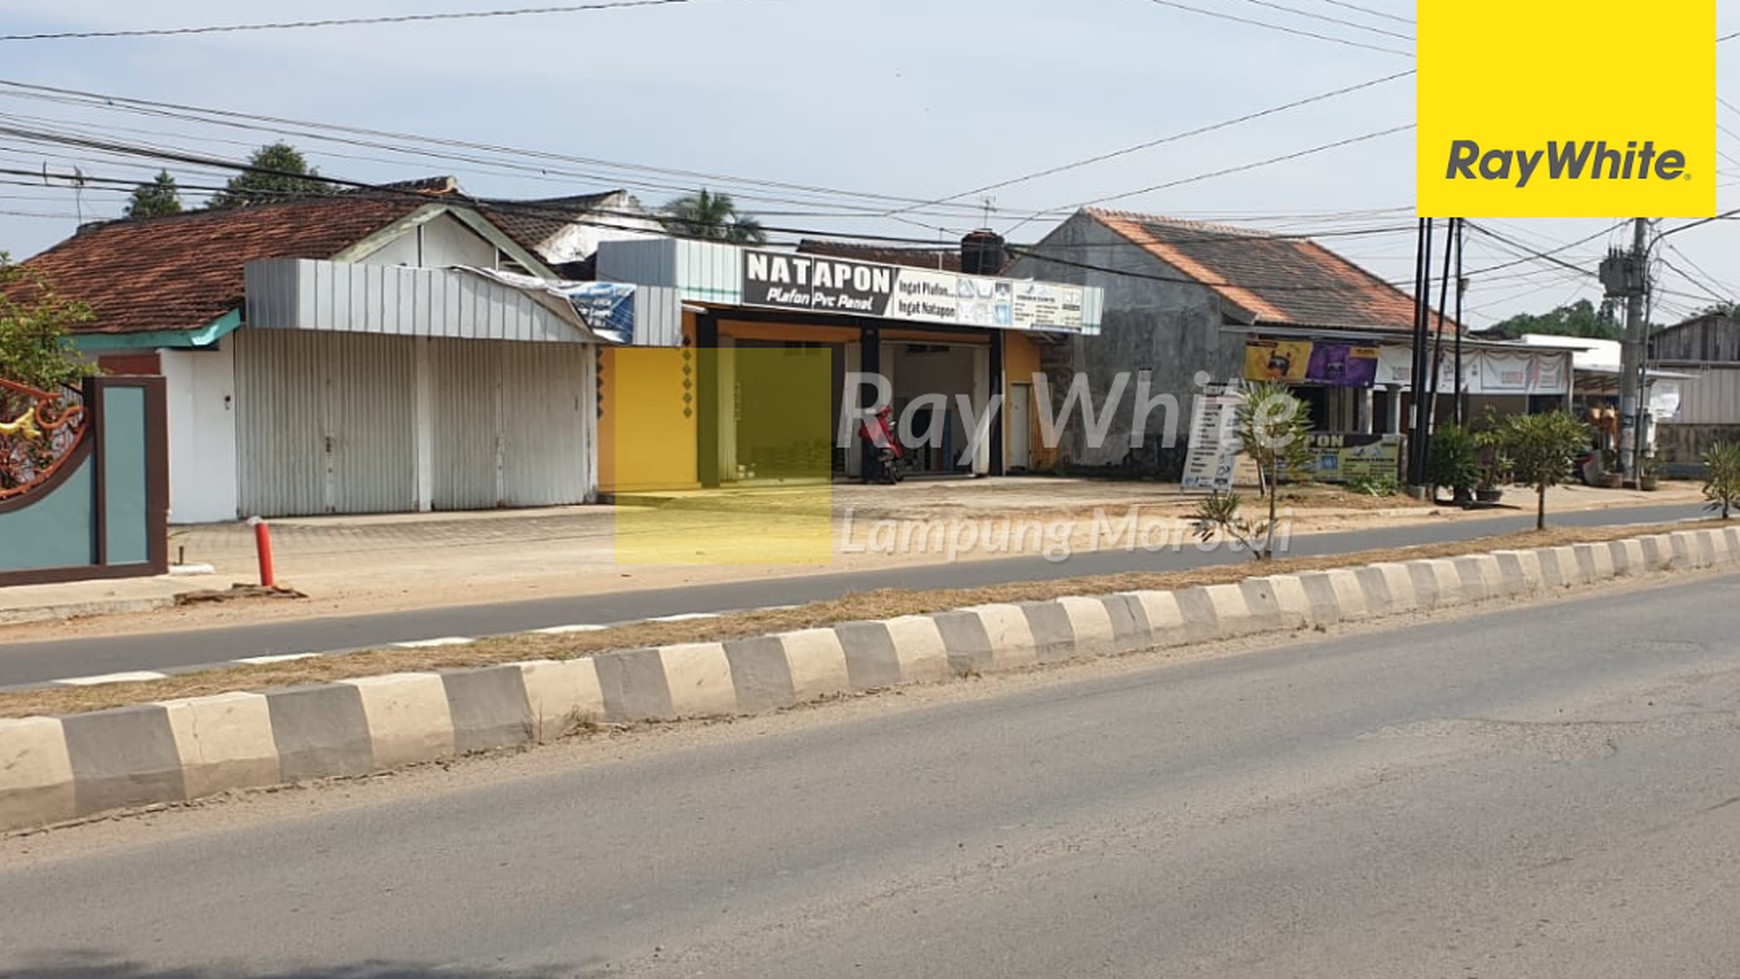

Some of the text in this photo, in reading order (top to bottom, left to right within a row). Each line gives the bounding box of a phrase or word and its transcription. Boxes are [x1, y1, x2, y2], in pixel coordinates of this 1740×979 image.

[747, 252, 891, 294] NATAPON
[898, 280, 921, 296] Ingat
[898, 299, 956, 319] Ingat Natapon
